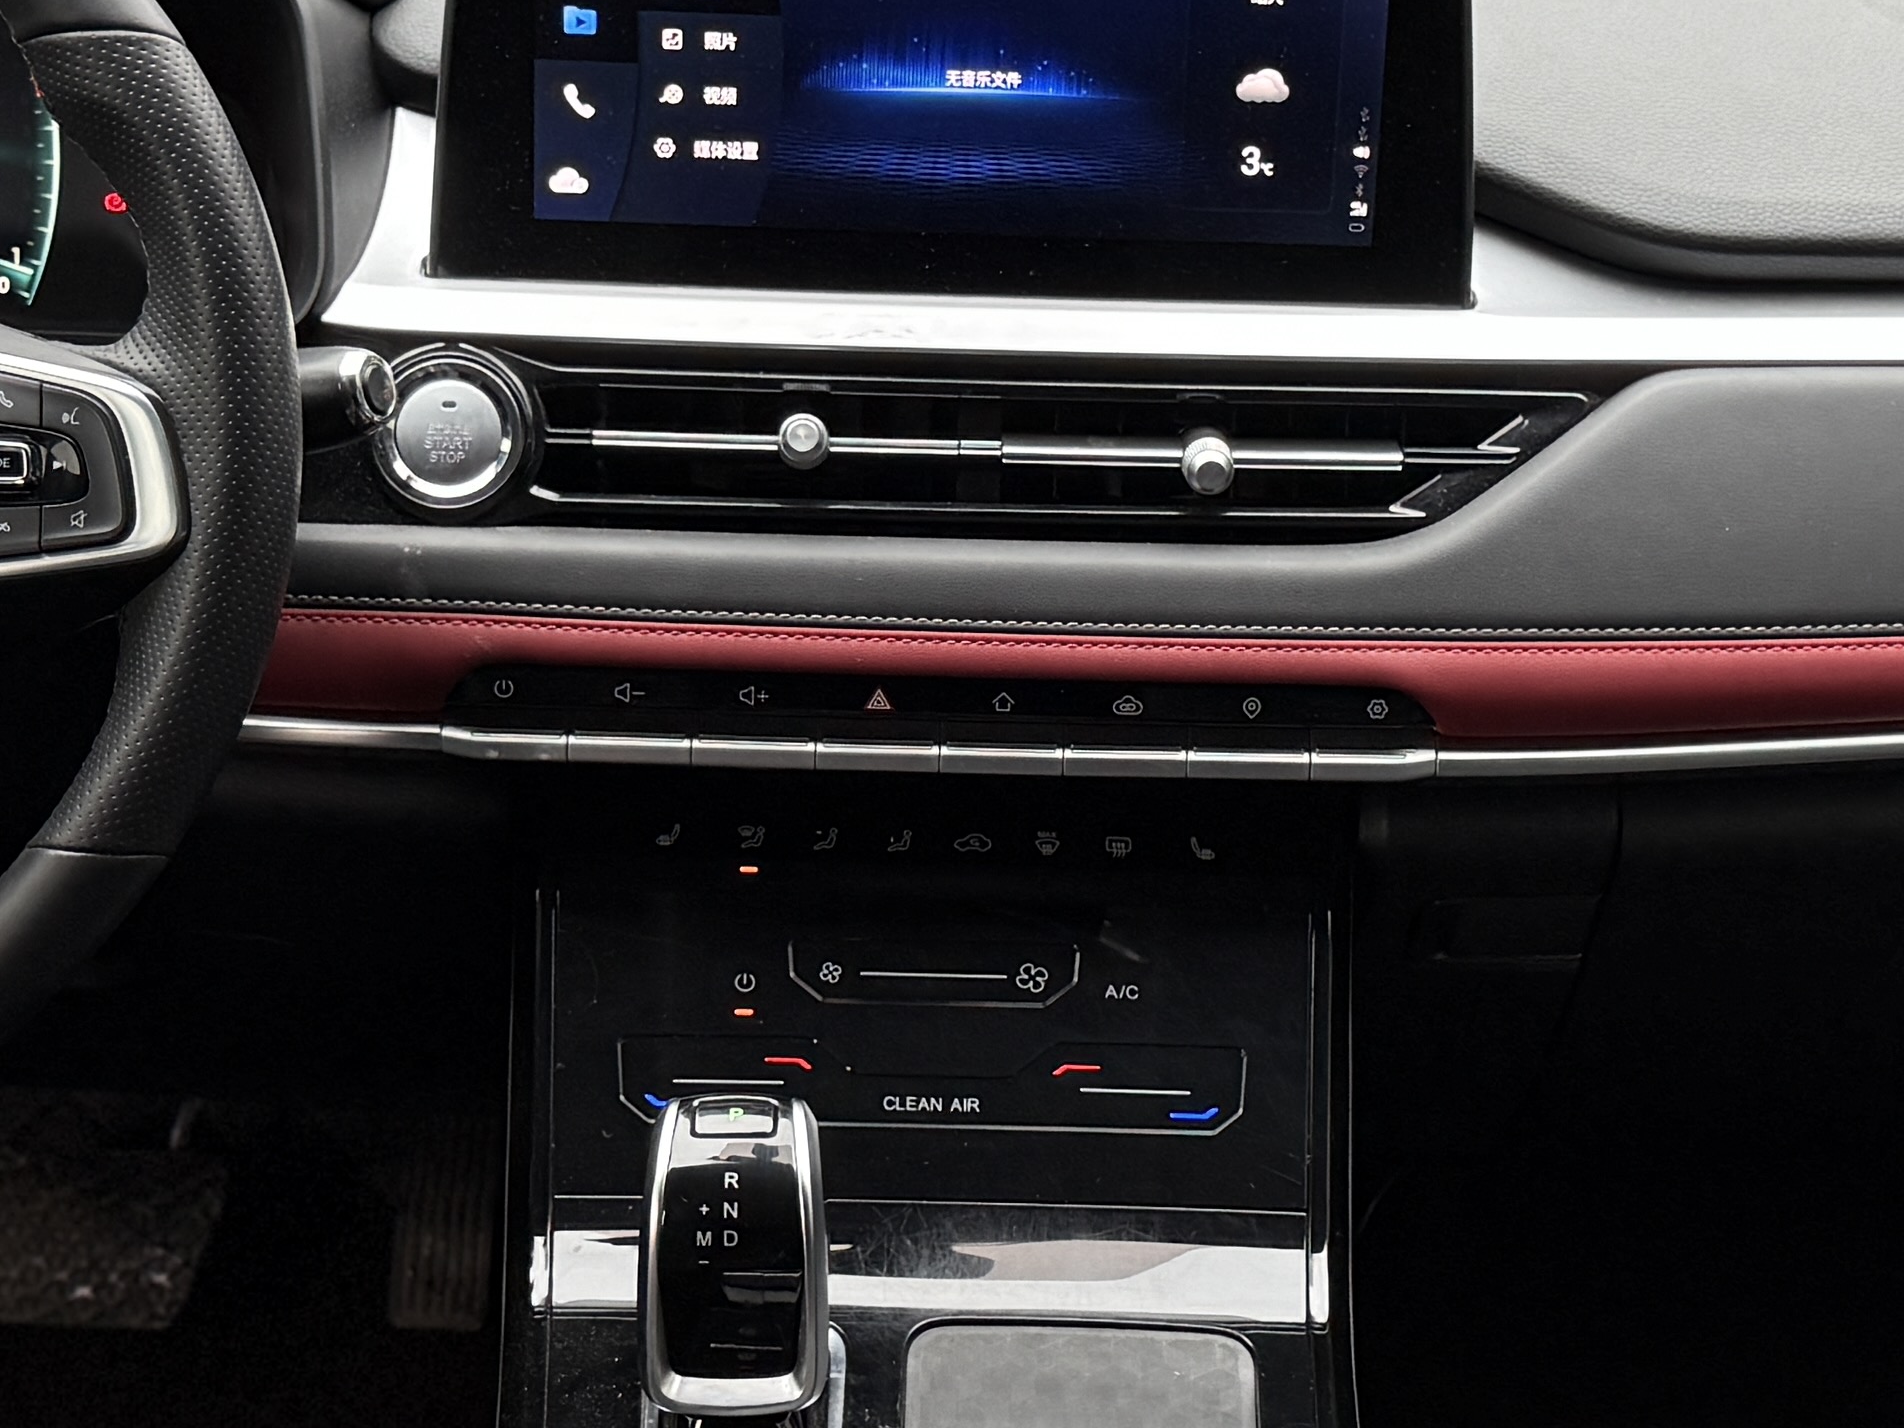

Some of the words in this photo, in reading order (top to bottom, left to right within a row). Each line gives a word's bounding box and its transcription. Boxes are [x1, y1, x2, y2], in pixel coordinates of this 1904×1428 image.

[703, 31, 738, 51] 照片
[945, 70, 1022, 89] 无音乐文件
[703, 86, 738, 106] 视频
[693, 140, 759, 160] 媒体设置
[423, 436, 473, 450] START
[429, 450, 466, 464] STOP
[1104, 984, 1140, 1000] A/C
[882, 1095, 943, 1112] CLEAN
[949, 1097, 981, 1113] AIR
[728, 1107, 745, 1122] P
[724, 1172, 739, 1189] R
[723, 1202, 739, 1219] N
[696, 1231, 712, 1247] M
[723, 1231, 739, 1247] D
